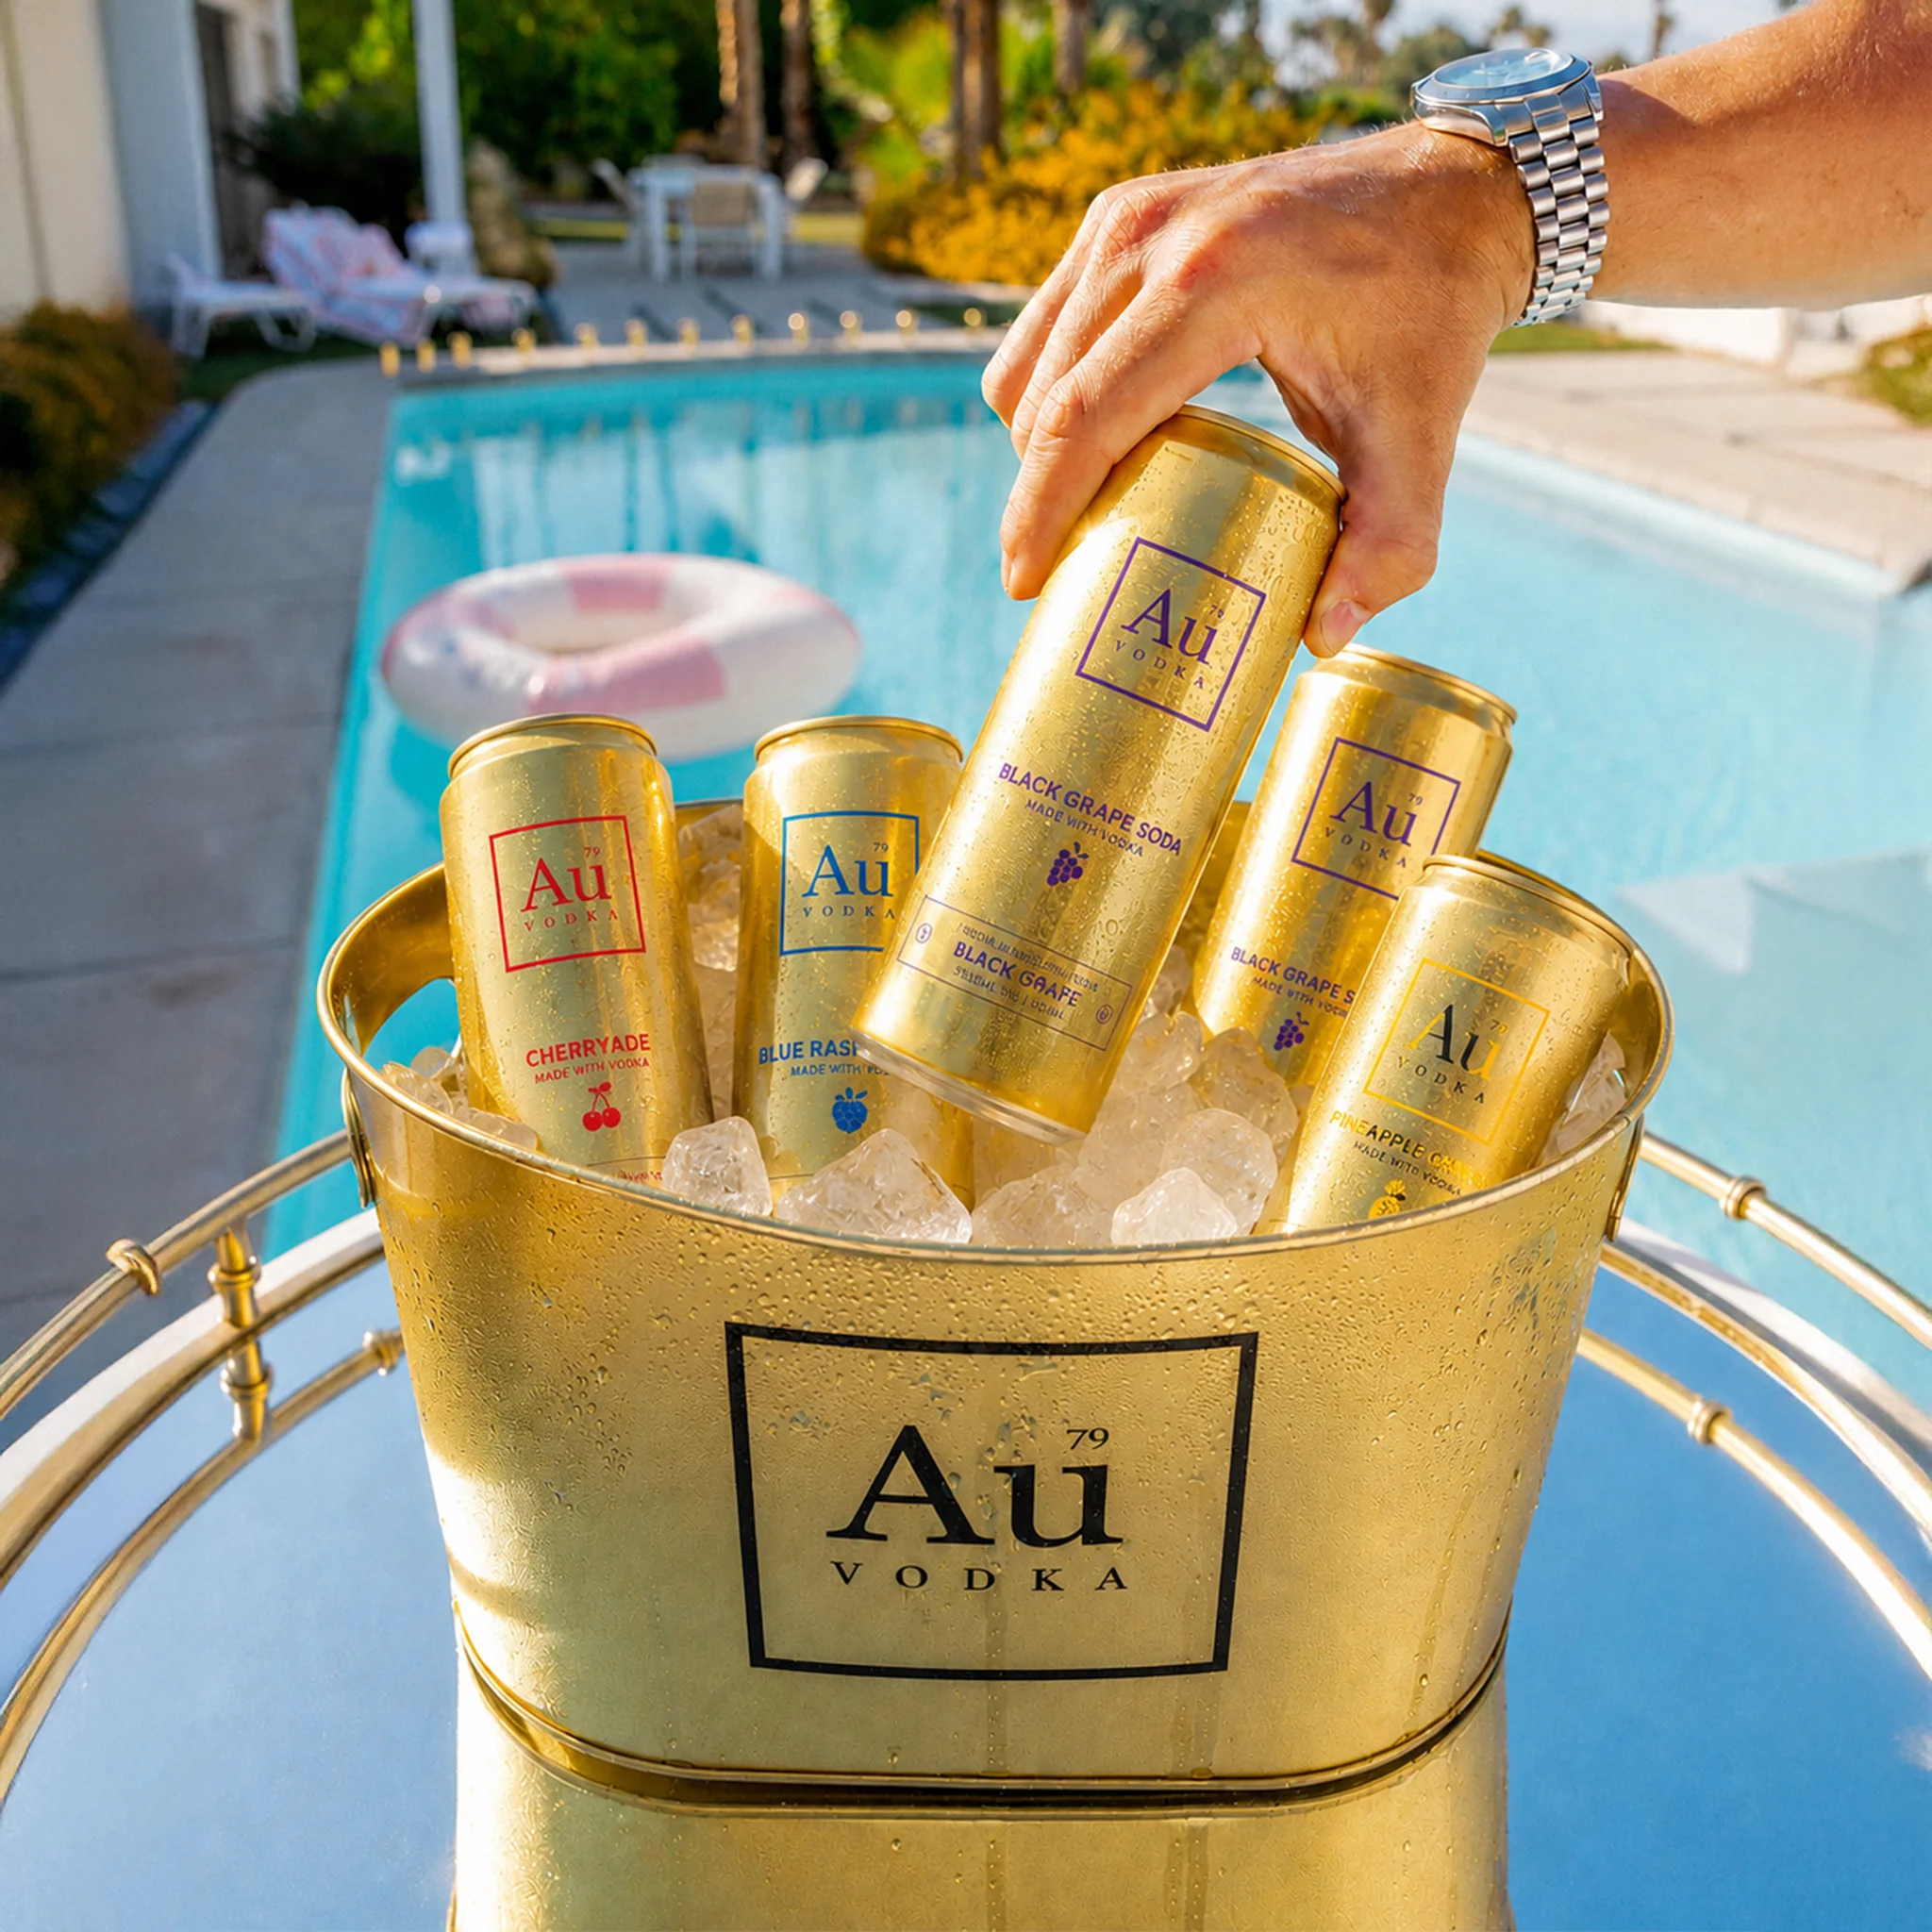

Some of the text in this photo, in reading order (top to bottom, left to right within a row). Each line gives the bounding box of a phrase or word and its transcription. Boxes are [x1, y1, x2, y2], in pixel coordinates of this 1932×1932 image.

[1120, 589, 1218, 665] Au
[1114, 640, 1205, 690] VODKA
[998, 762, 1182, 857] BLACK GRAPE SODA
[1025, 798, 1064, 823] MADE
[1066, 814, 1099, 837] WITH
[1328, 781, 1418, 848] Au
[801, 841, 894, 898] Au 79
[1324, 826, 1407, 869] VODKA
[520, 846, 613, 913] Au 79
[525, 908, 618, 932] VODKA
[802, 905, 895, 920] VODKA
[952, 941, 1015, 981] BLACK
[1230, 946, 1283, 977] BLACK
[1282, 966, 1342, 1000] GRAPE
[525, 1033, 651, 1068] CHERRYADE
[758, 1041, 805, 1065] BLUE
[1404, 1004, 1501, 1081] Au
[535, 1057, 650, 1084] MADE WITH VODKA
[791, 1063, 826, 1076] MADE
[828, 1063, 862, 1075] WITH
[1397, 1055, 1485, 1105] VODKA
[1328, 1109, 1426, 1159] PINEAPPLE
[825, 1424, 1124, 1548] Au 79
[829, 1560, 1128, 1592] VODKA
